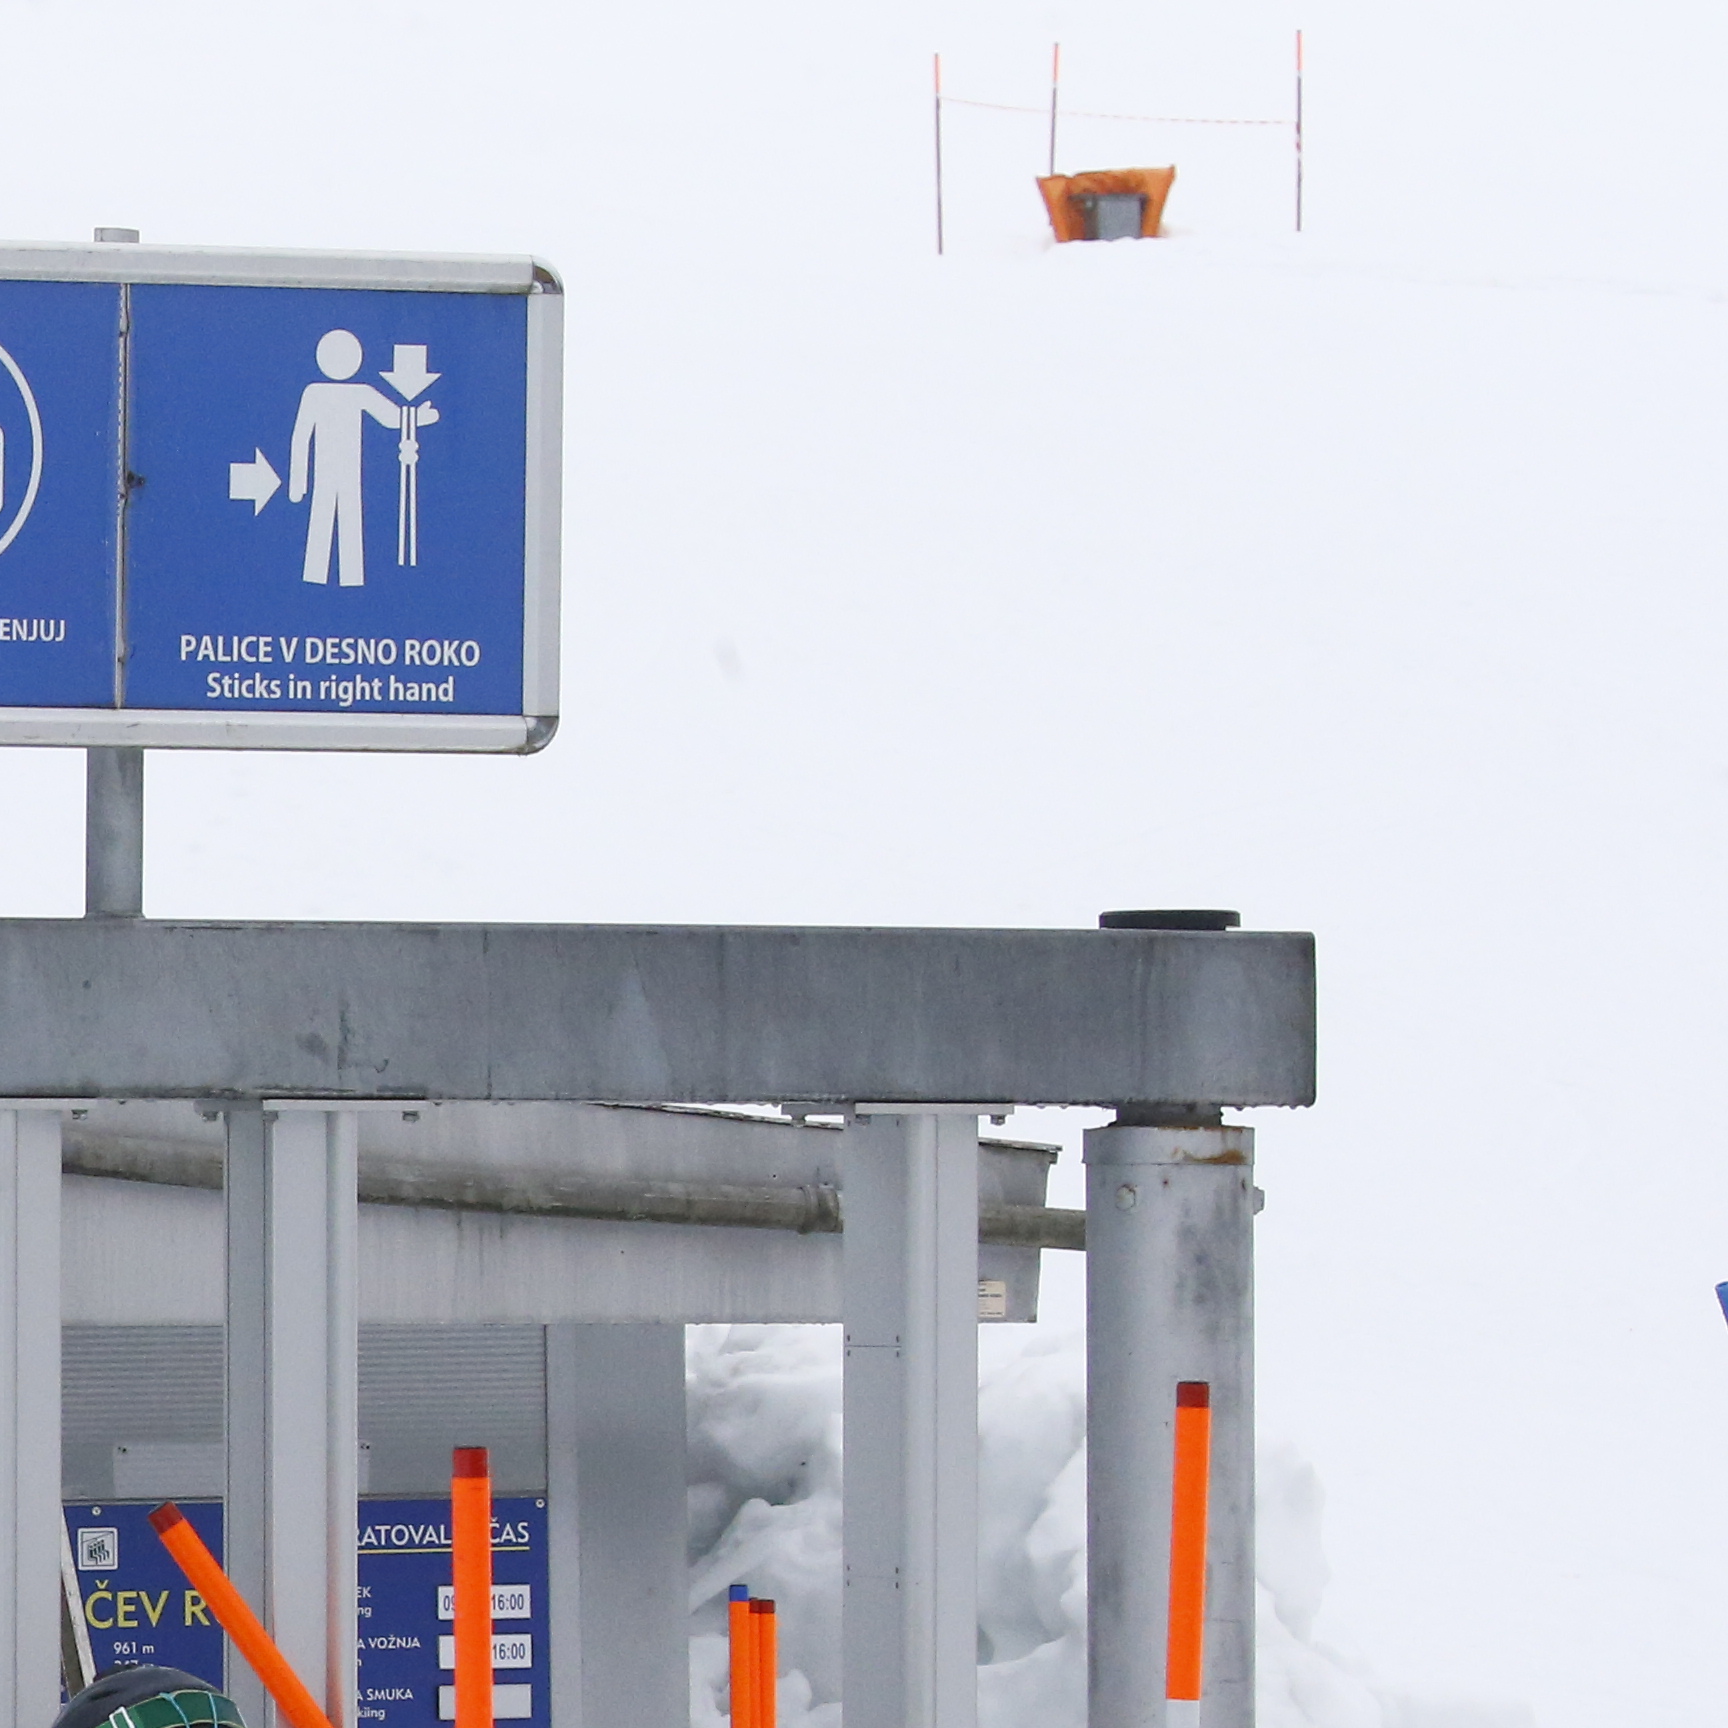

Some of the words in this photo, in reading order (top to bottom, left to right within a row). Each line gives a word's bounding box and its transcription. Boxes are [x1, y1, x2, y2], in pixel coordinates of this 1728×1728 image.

[181, 635, 272, 662] PALICE
[280, 637, 298, 662] V
[306, 638, 396, 664] DESNO
[405, 640, 480, 666] ROKO
[207, 673, 281, 698] Sticks
[289, 674, 311, 699] in
[320, 674, 382, 706] right
[390, 675, 453, 701] hand
[358, 1525, 452, 1545] ATOVAL
[85, 1579, 170, 1629] ČEV
[113, 1641, 137, 1655] 961
[142, 1645, 155, 1654] m
[369, 1635, 421, 1649] VOŽNJA
[493, 1643, 525, 1660] 16:00
[367, 1688, 414, 1700] SMUKA
